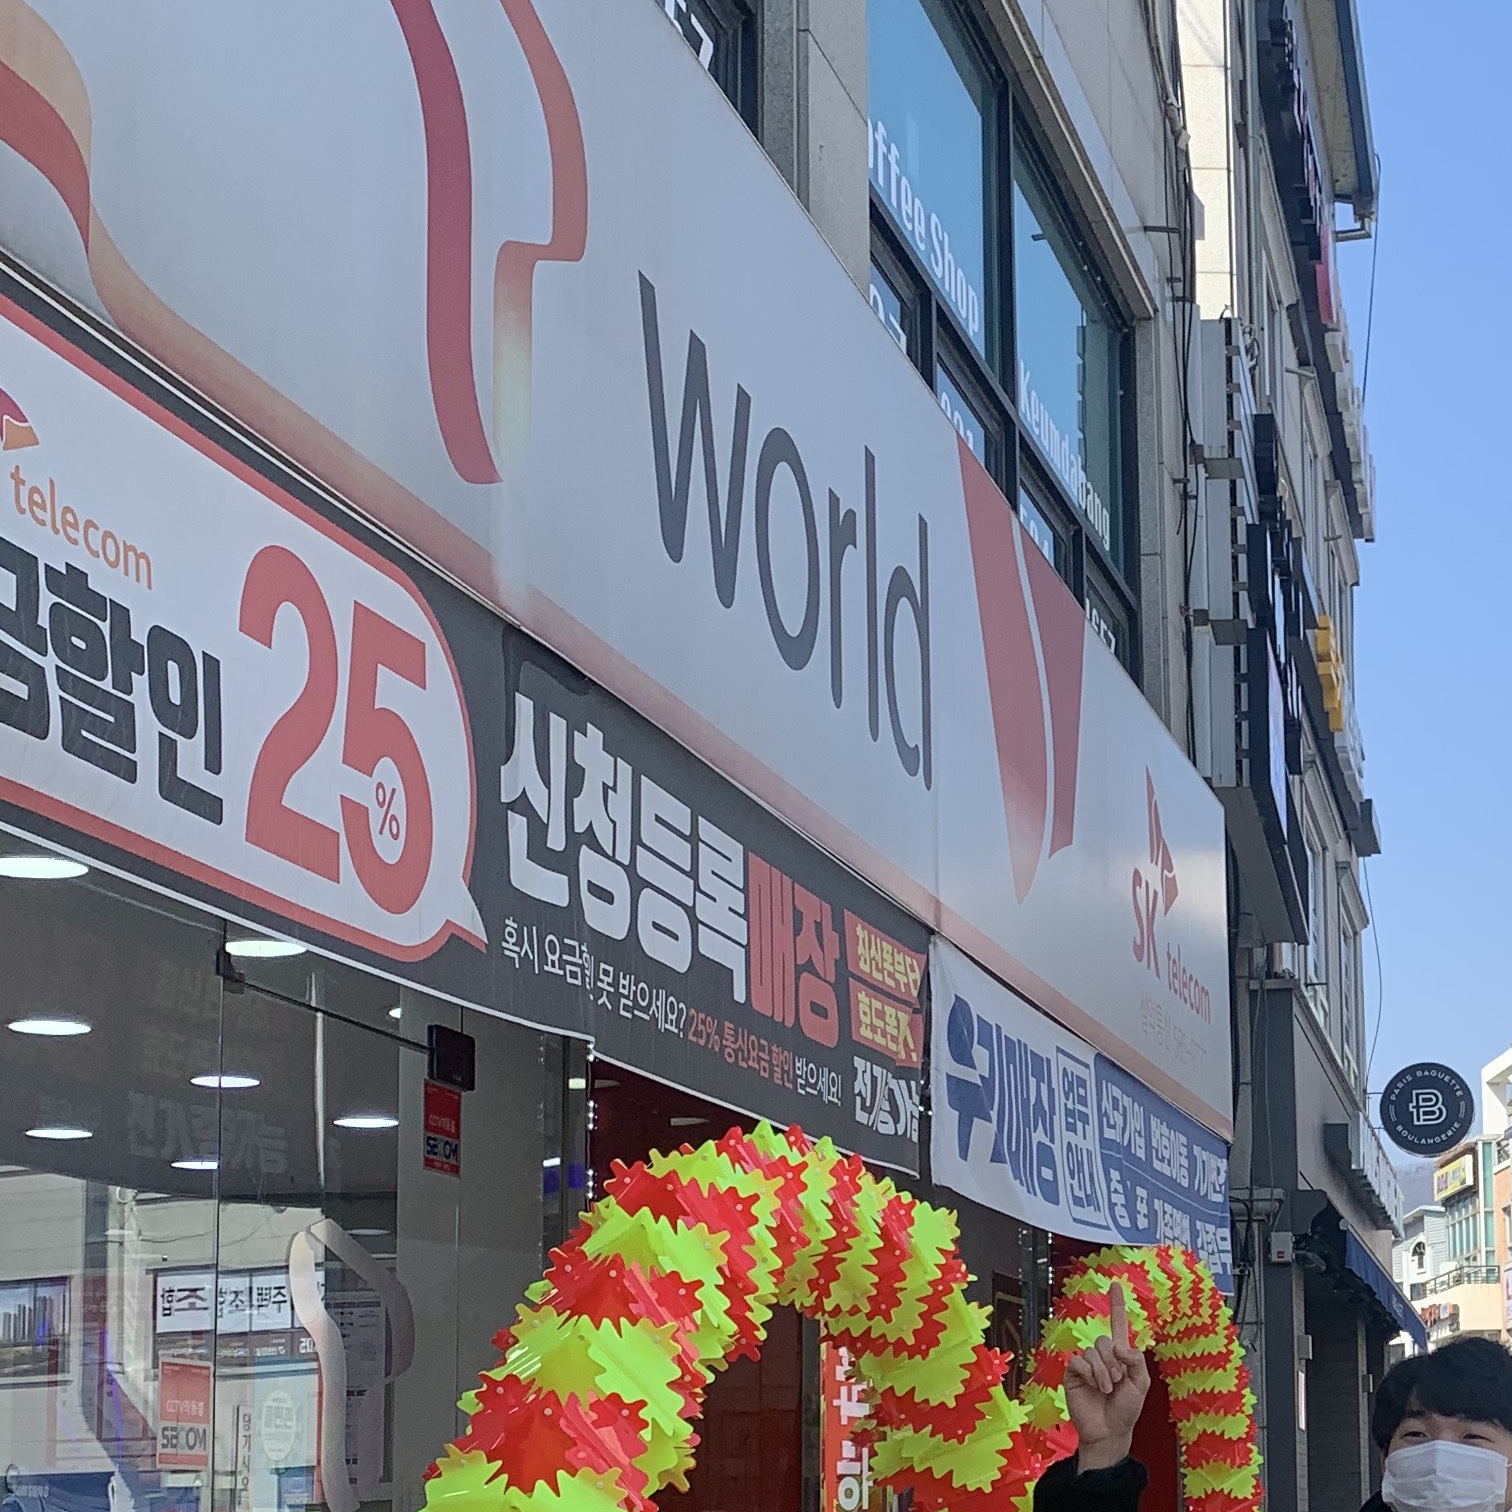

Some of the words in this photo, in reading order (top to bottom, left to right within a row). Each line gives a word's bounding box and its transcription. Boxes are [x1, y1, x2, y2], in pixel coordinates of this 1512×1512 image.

[930, 213, 980, 337] Shop
[11, 465, 153, 591] telecom
[1132, 864, 1160, 979] SK
[501, 915, 538, 974] 혹시
[597, 961, 615, 1010] 못
[619, 970, 687, 1038] 받으세요?
[687, 1008, 720, 1053] 25%
[722, 1020, 769, 1079] 통신요금
[772, 1042, 794, 1090] 할인
[794, 1057, 842, 1107] 받으세요!
[1167, 943, 1211, 1025] telecom
[1062, 1066, 1091, 1141] 업무
[1390, 1074, 1413, 1101] PARIS
[1415, 1069, 1464, 1098] BAGUETTE
[1066, 1141, 1101, 1213] 안내
[1101, 1079, 1146, 1162] 신규가입
[1150, 1113, 1189, 1188] 번호이동
[1395, 1121, 1461, 1145] BOULANGERIE
